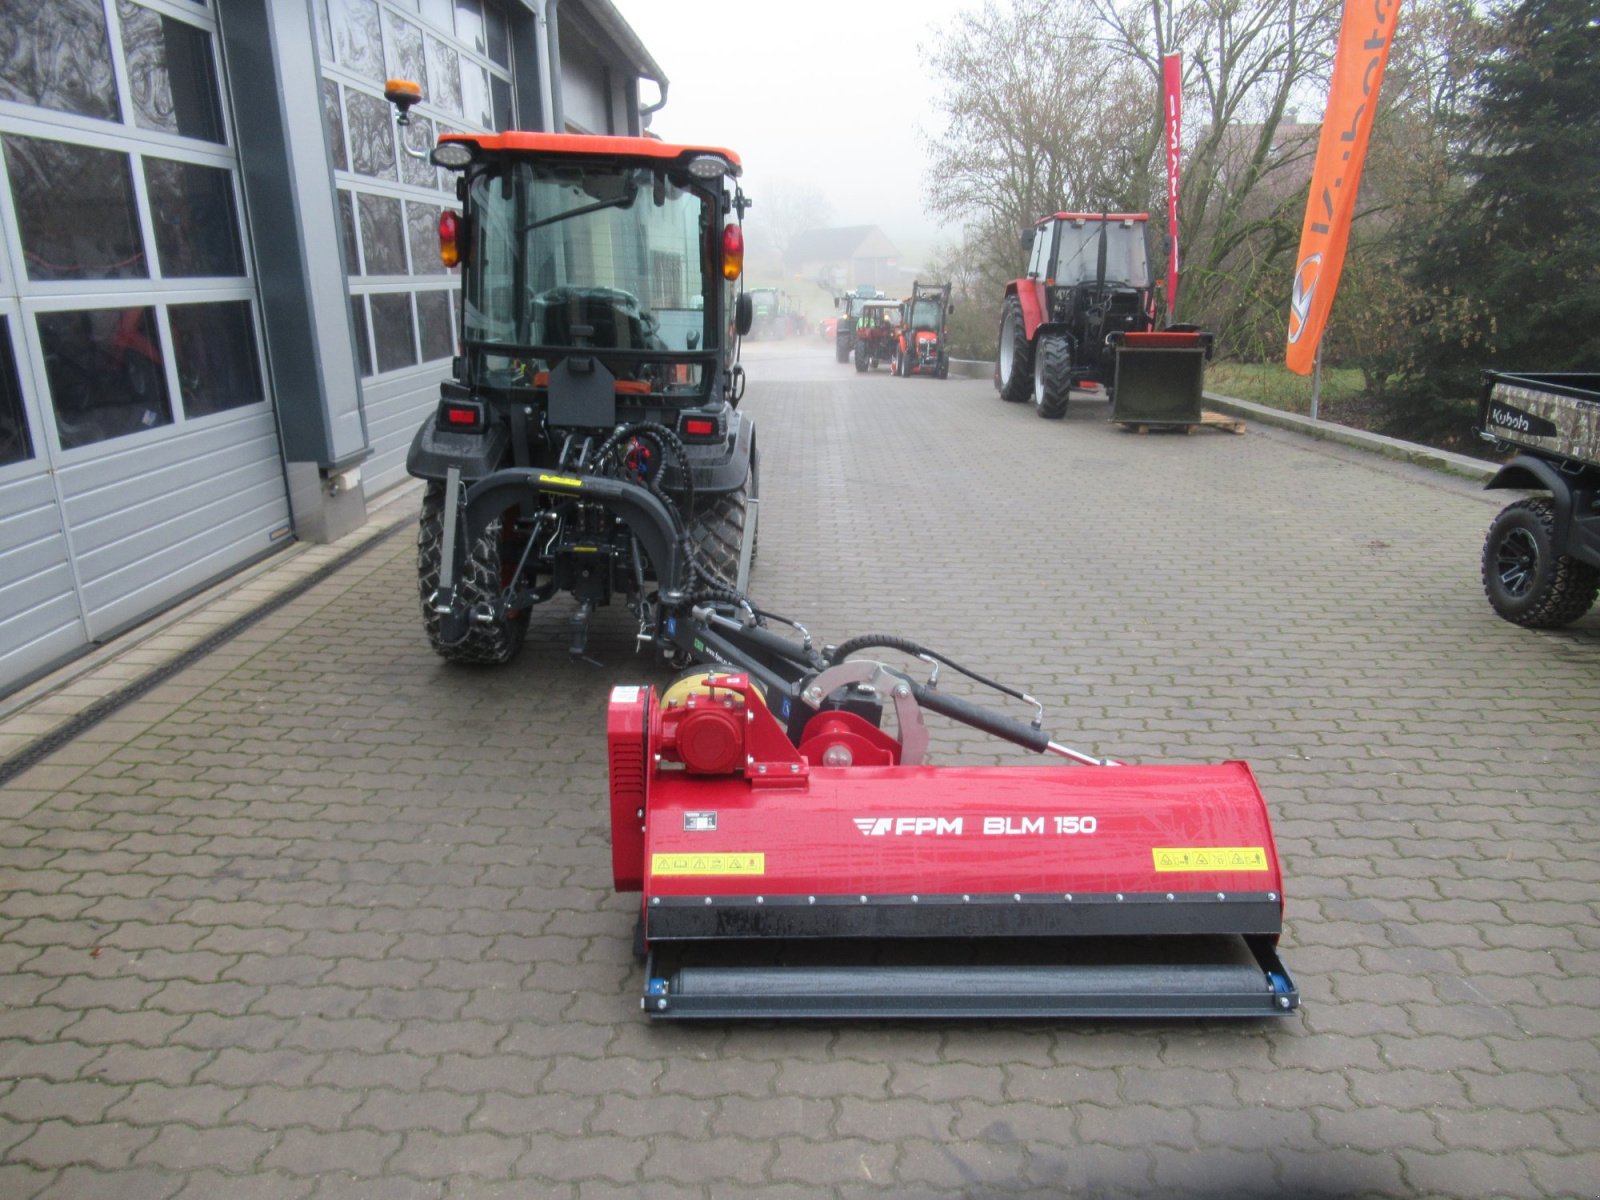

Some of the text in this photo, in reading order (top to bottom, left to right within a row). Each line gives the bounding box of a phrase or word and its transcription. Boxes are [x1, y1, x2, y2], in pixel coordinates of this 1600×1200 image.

[1492, 408, 1529, 431] Kubota
[895, 816, 1098, 835] FPM BLM 150
